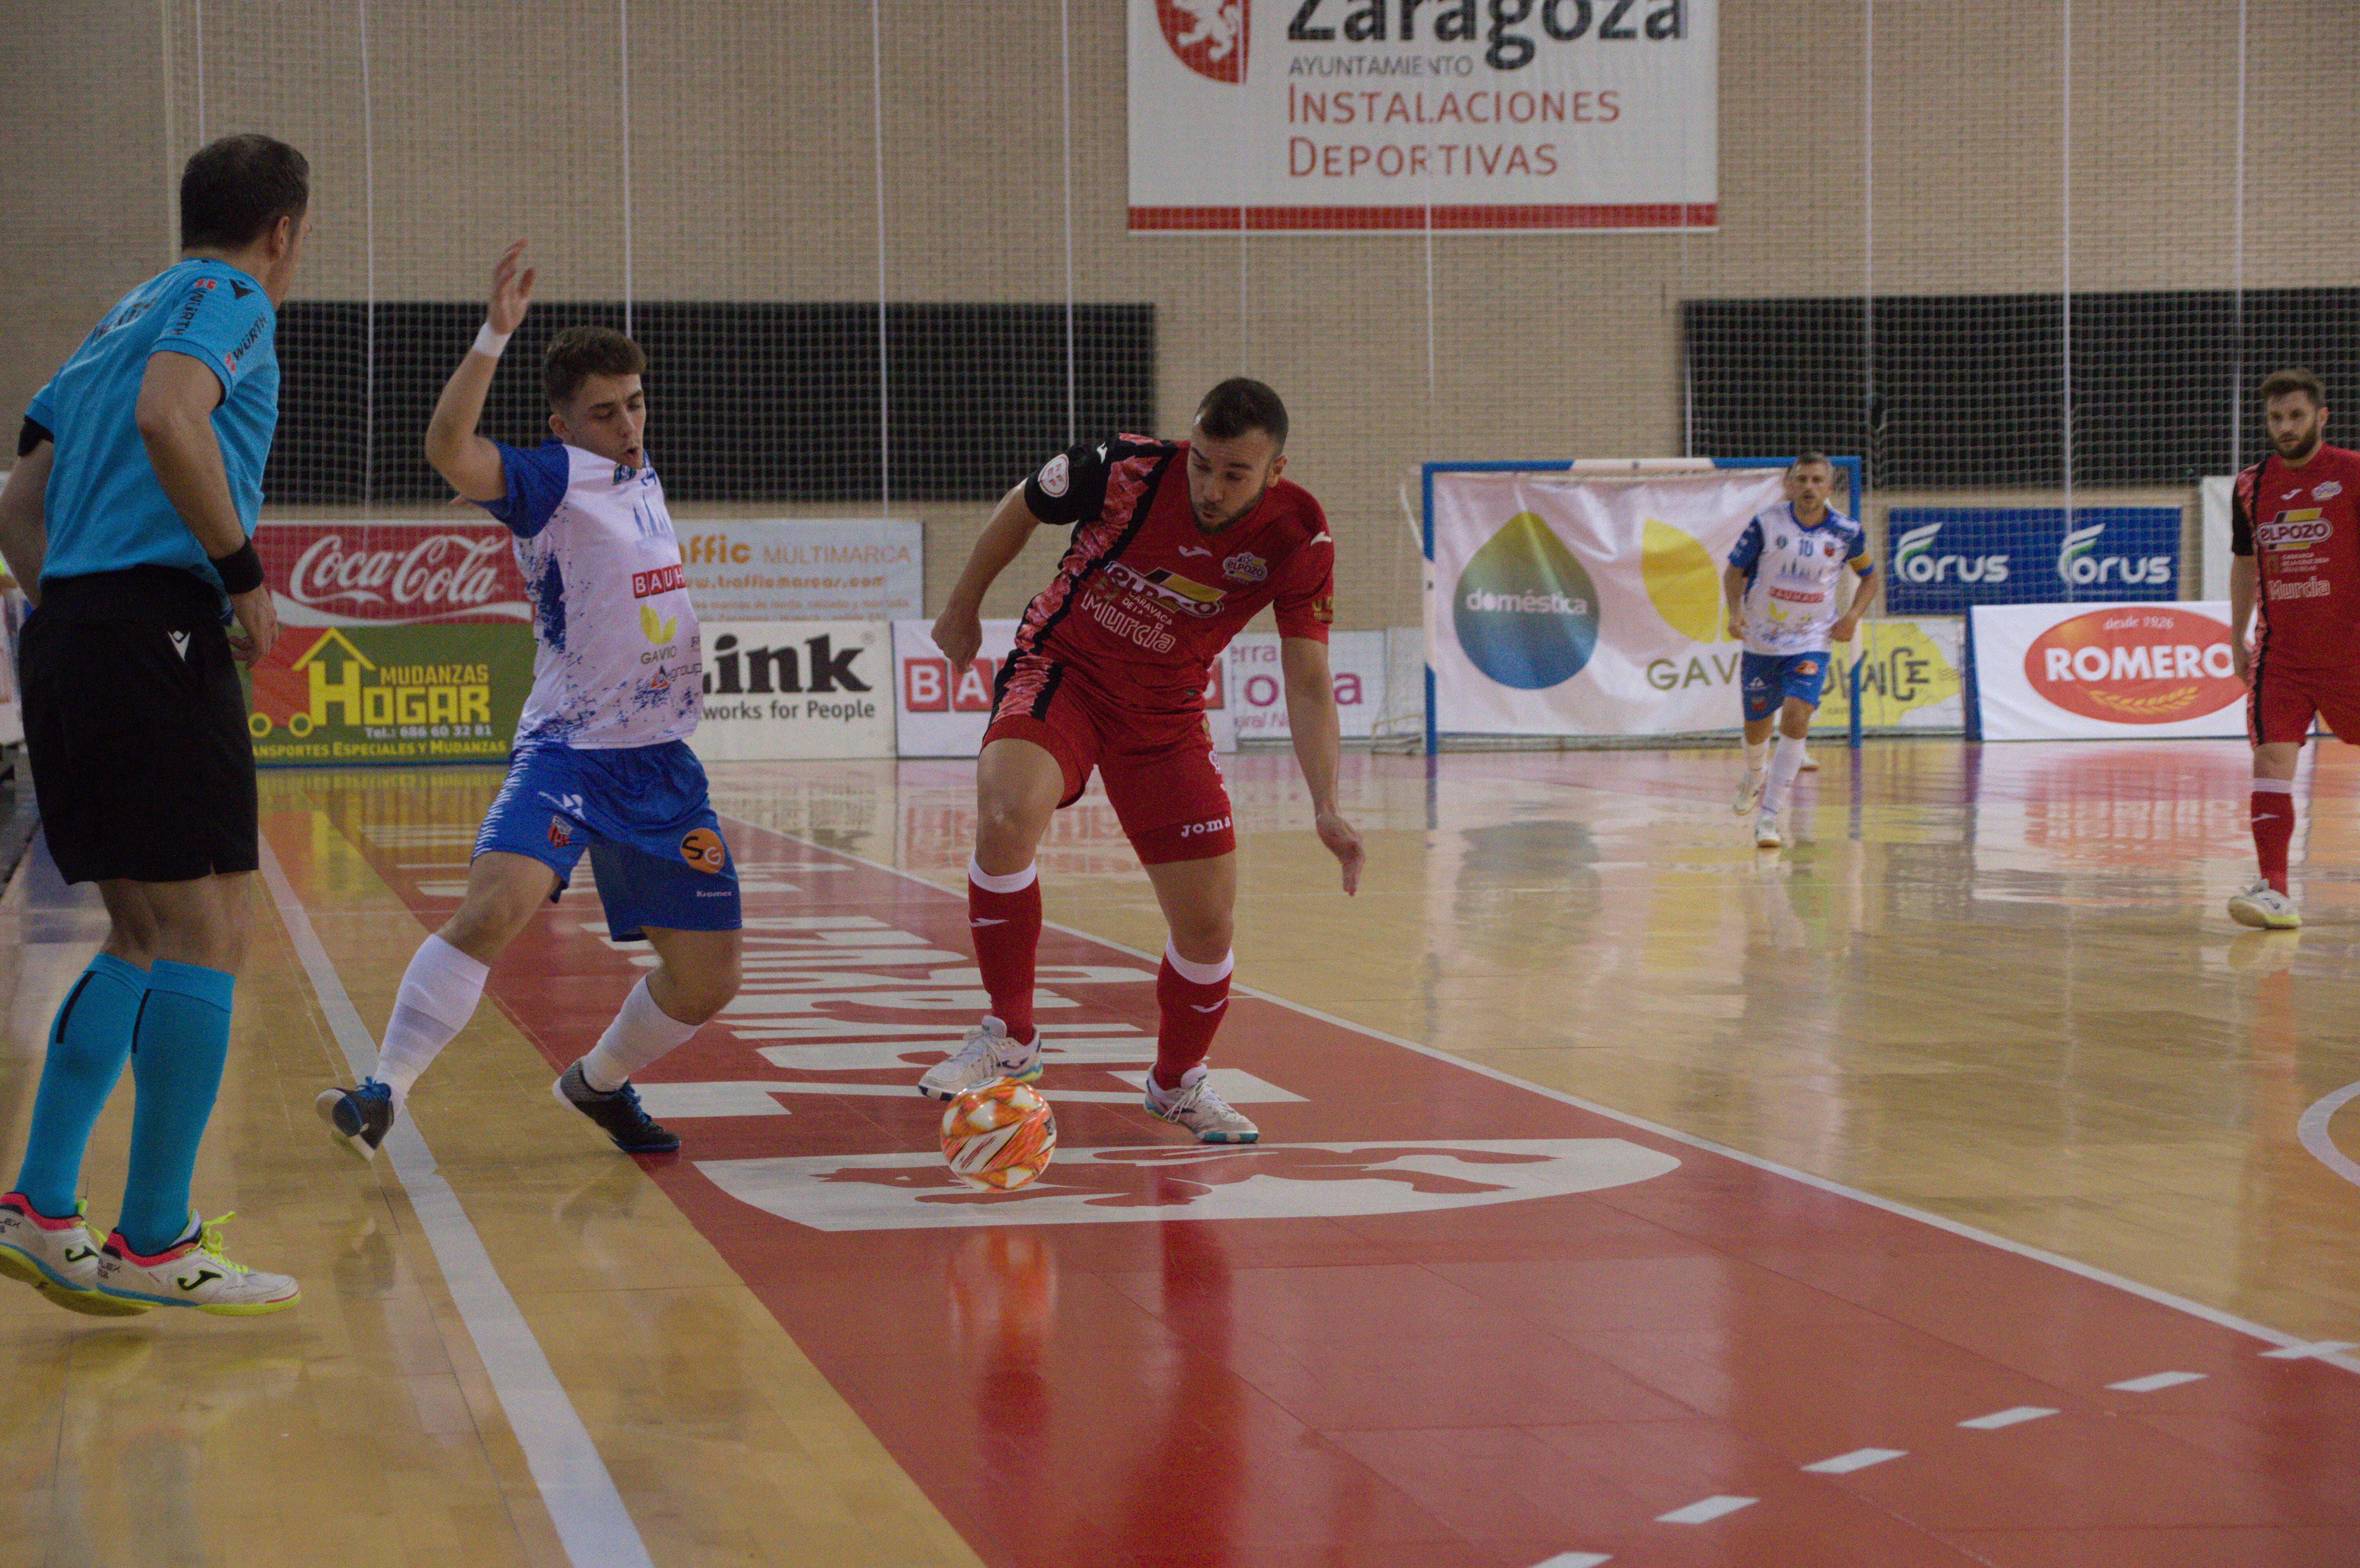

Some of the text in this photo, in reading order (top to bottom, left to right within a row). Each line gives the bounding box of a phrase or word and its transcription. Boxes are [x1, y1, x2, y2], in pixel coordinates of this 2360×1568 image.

[1287, 0, 1688, 70] Zaragoza
[1289, 56, 1474, 78] AYUNTAMIENTO
[233, 313, 267, 360] WÜRTH
[764, 545, 912, 565] MULTIMARCA
[1799, 538, 1814, 557] 10
[289, 535, 510, 605] Coca-Cola
[2269, 576, 2331, 600] Murcia
[1129, 591, 1173, 625] CARAVACA
[1466, 589, 1587, 615] doméstica
[1081, 589, 1176, 653] Murcia
[2142, 616, 2174, 629] 1926
[641, 646, 677, 665] GAVIO
[703, 633, 873, 694] ink
[2045, 643, 2235, 681] ROMERO
[380, 663, 489, 686] MUDANZAS
[309, 659, 491, 727] HOGAR
[770, 700, 799, 717] for
[807, 699, 875, 722] People
[399, 726, 427, 738] 686
[430, 726, 449, 738] 60
[453, 725, 470, 737] 32
[475, 725, 492, 737] 81
[253, 744, 329, 757] ANSPORTES
[417, 743, 426, 754] Y
[430, 740, 507, 755] MUDANZAS
[682, 836, 721, 865] SG
